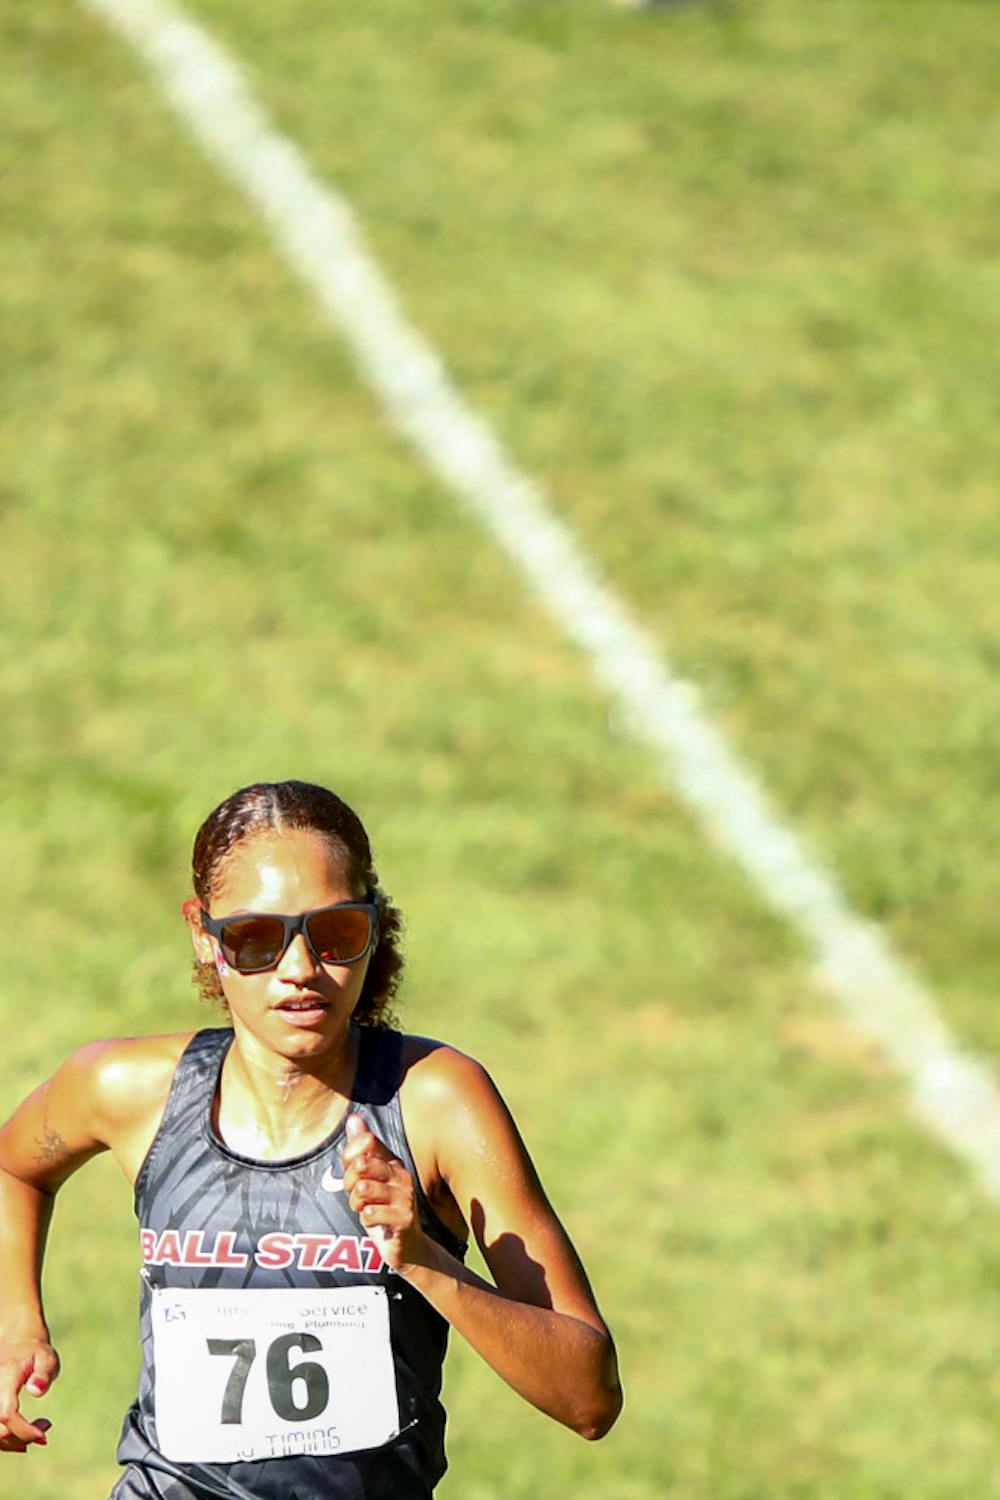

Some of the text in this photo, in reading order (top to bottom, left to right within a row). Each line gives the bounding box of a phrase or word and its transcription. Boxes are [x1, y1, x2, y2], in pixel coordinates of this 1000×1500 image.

[140, 1228, 397, 1273] BALL STAT
[206, 1332, 330, 1425] 76
